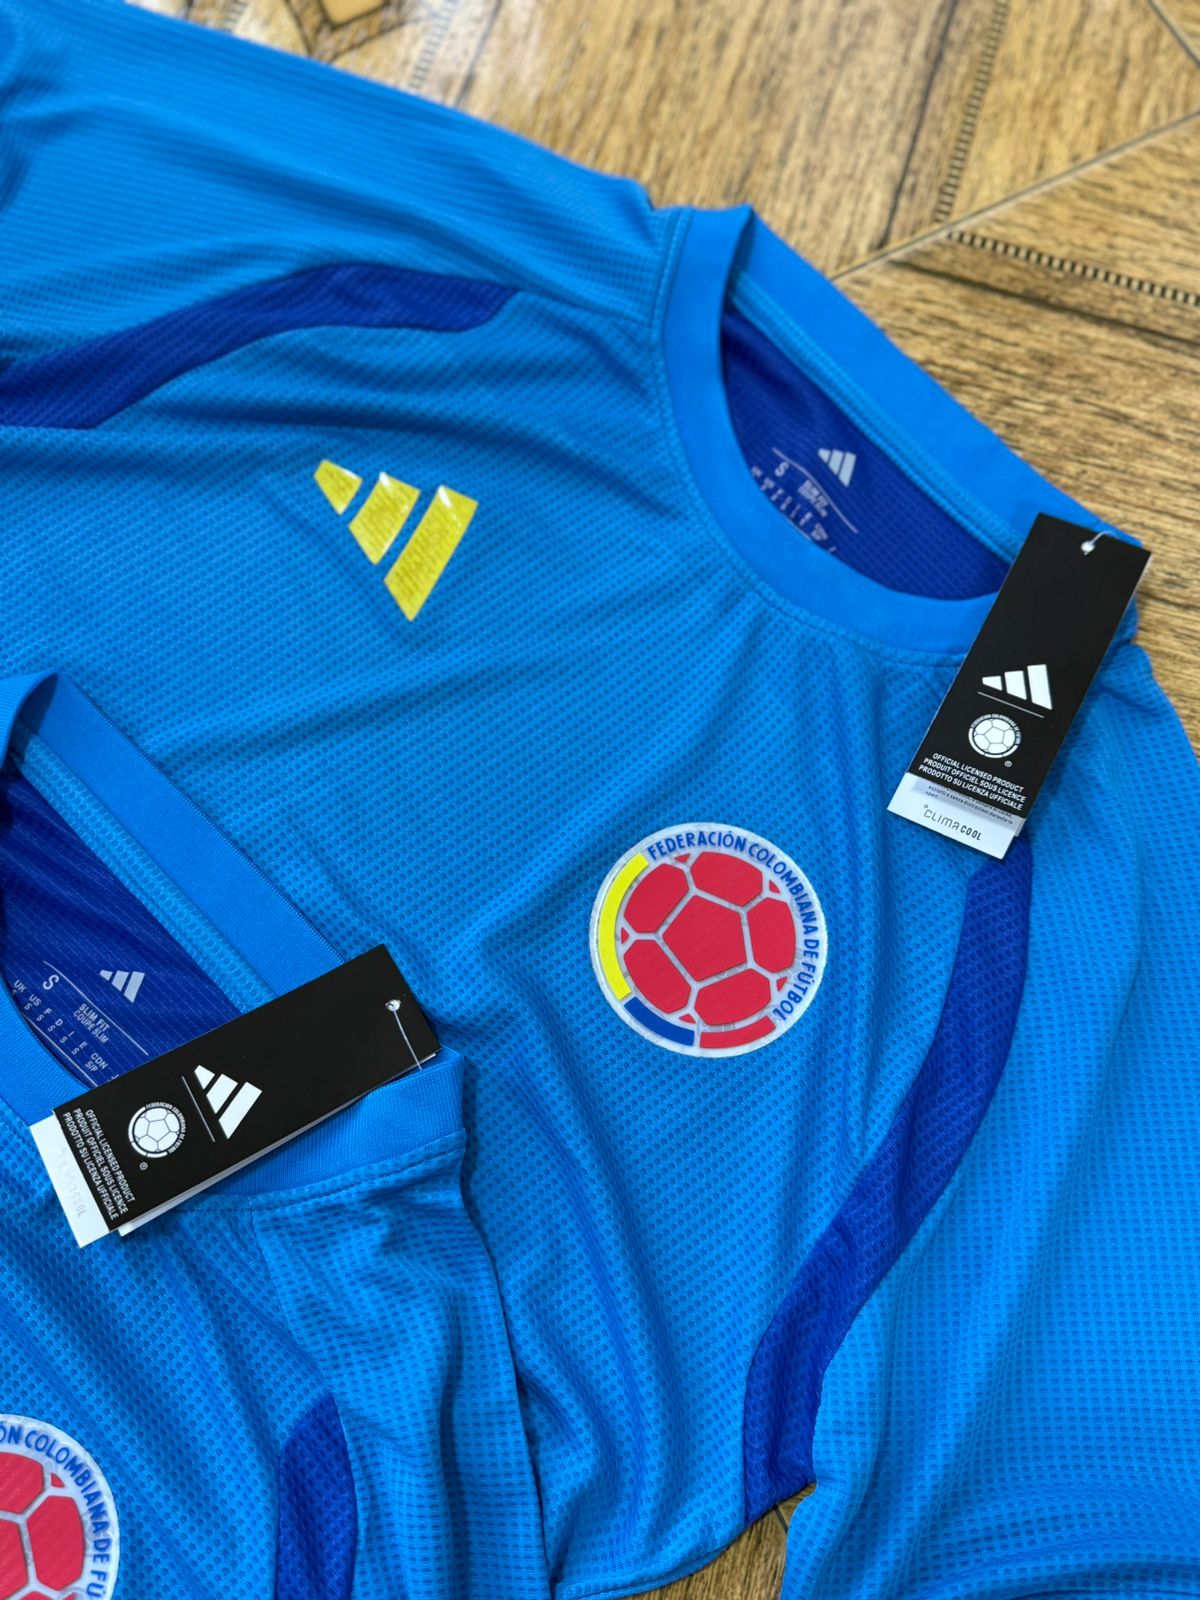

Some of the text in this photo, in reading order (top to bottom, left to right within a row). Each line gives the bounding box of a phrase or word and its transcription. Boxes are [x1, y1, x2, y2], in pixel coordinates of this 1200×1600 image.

[774, 461, 789, 477] S
[918, 764, 953, 782] PRODOTTO
[953, 778, 962, 786] SU
[962, 782, 988, 797] LICENZA
[989, 793, 1022, 810] UFFICIALE
[924, 758, 950, 773] PRODUIT
[951, 768, 981, 784] OFFICIEL
[980, 780, 998, 792] SOUS
[997, 788, 1026, 802] LICENCE
[933, 753, 1024, 792] OFFICIAL LICENSED PRODUCT
[647, 830, 820, 1022] FEDERACIÓN COLOMBIANA DE FÚTBOL
[42, 974, 60, 990] S
[14, 980, 27, 992] UK
[29, 994, 42, 1006] US
[55, 1018, 64, 1026] D
[91, 1052, 108, 1070] CDN
[73, 1010, 110, 1044] COUPE SLIM
[80, 1003, 110, 1031] SLIM FIT
[85, 1061, 98, 1072] S/P
[63, 1112, 85, 1148] PRODOTTO
[74, 1108, 93, 1137] PRODUIT
[86, 1136, 105, 1167] OFFICIEL
[100, 1166, 114, 1186] SOUS
[108, 1182, 129, 1214] LICENCE
[80, 1147, 90, 1158] SU
[85, 1109, 136, 1202] OFFICIAL LICENSED PRODUCT
[84, 1156, 102, 1186] LICENZA
[97, 1185, 120, 1220] UFFICIALE
[25, 1430, 110, 1533] COLOMBIANA
[92, 1538, 112, 1562] DE
